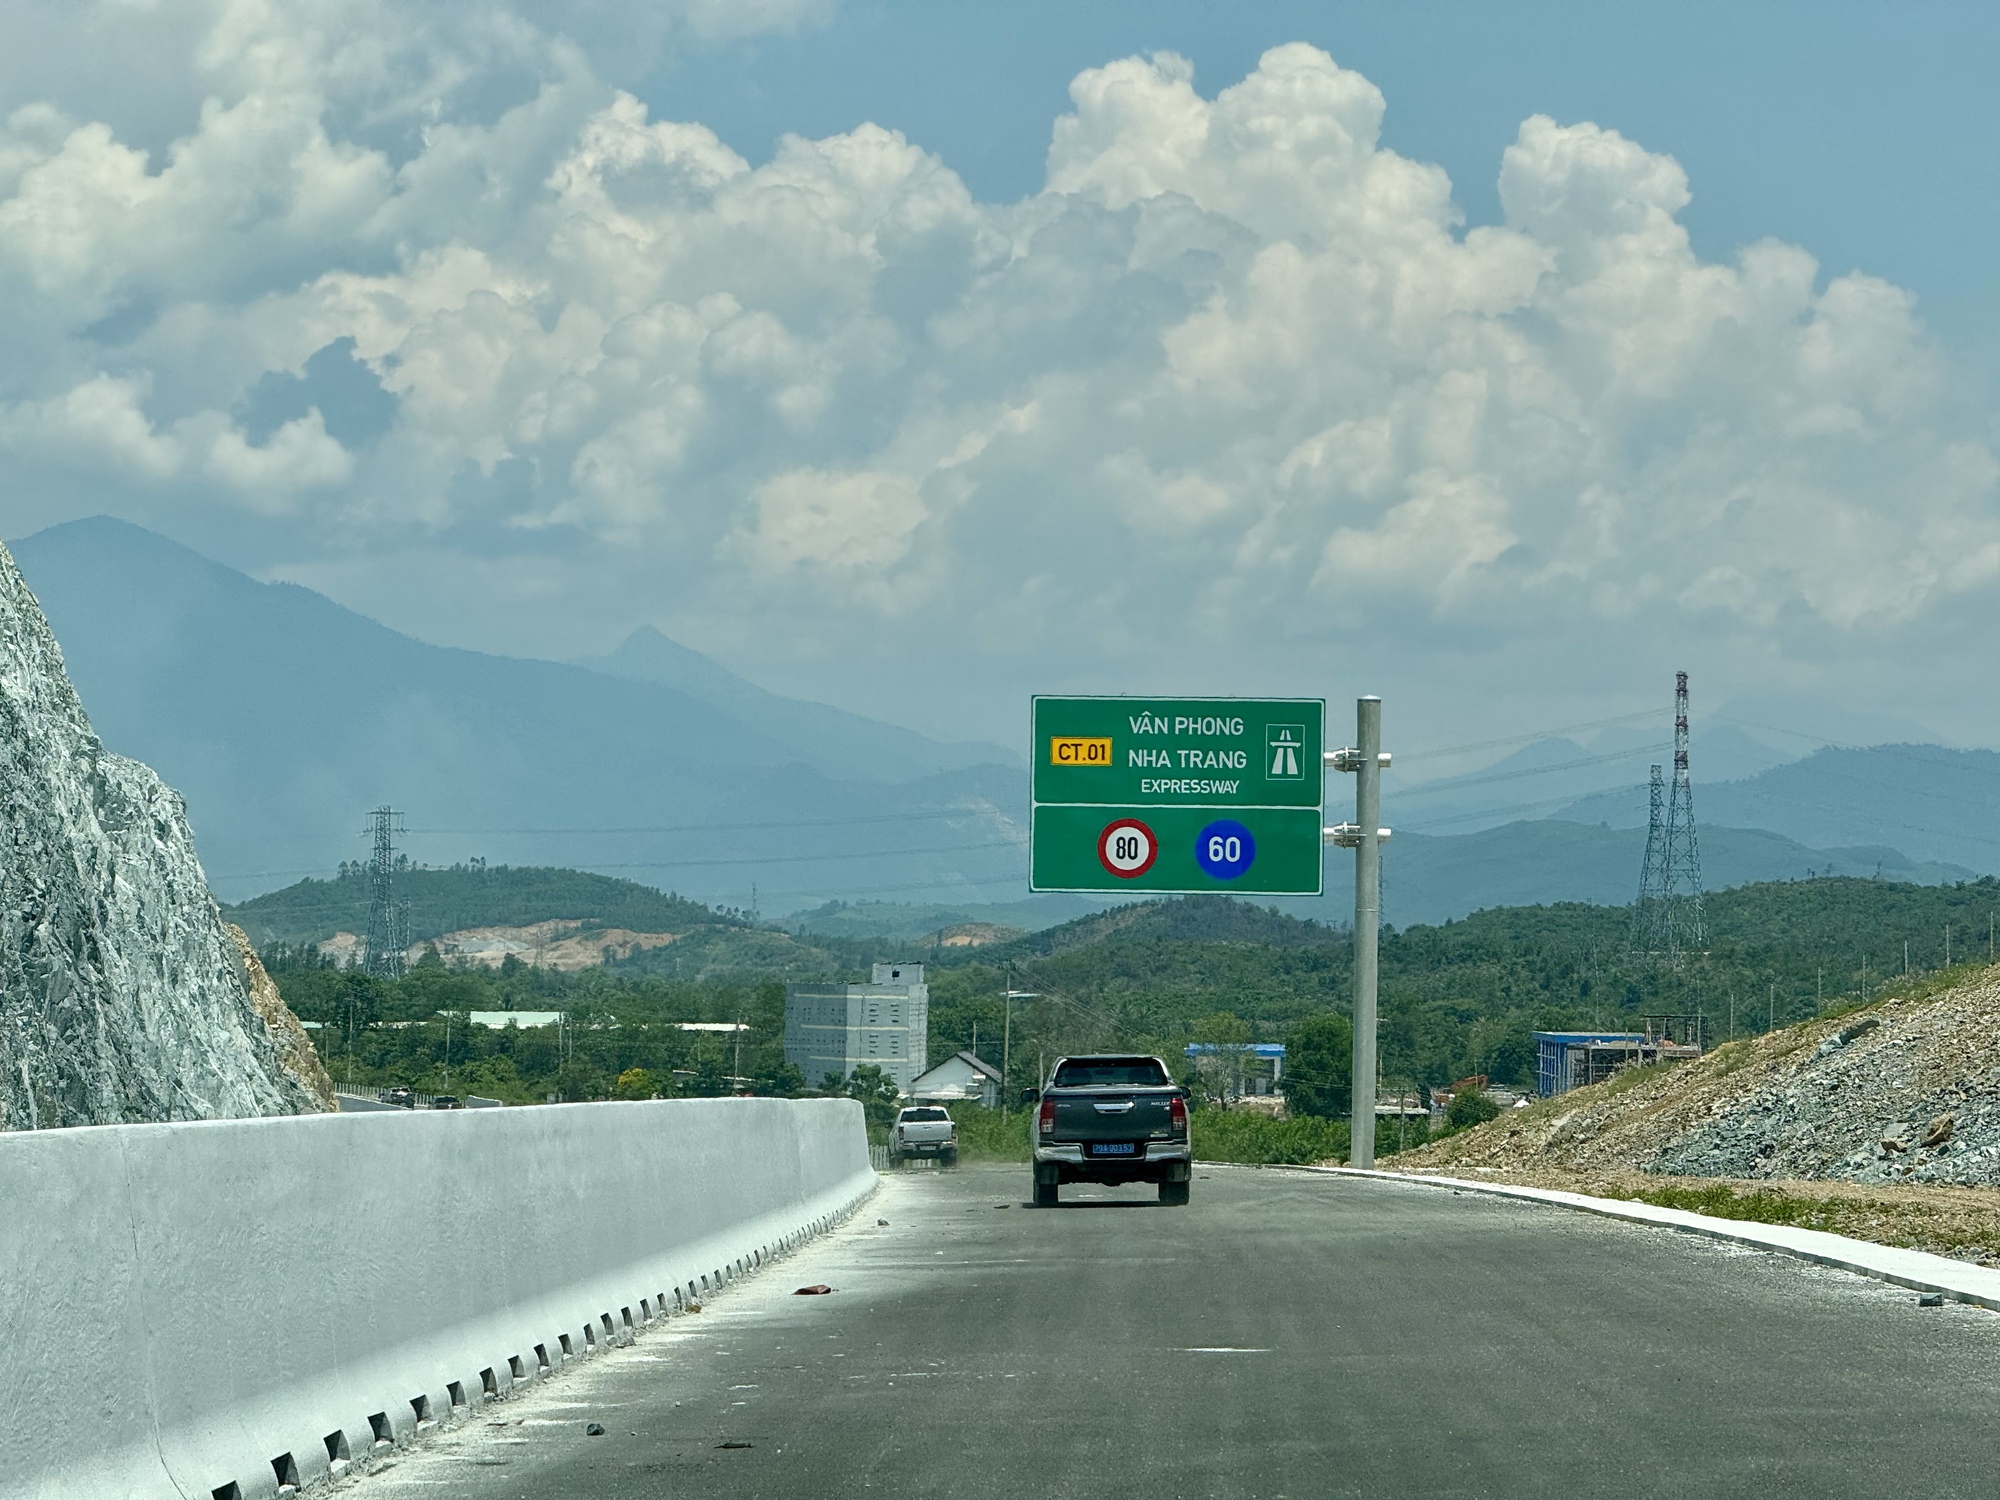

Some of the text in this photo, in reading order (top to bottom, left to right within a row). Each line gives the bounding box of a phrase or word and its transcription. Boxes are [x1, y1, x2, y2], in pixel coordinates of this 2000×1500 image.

[1129, 711, 1244, 735] VÂN PHONG
[1058, 743, 1107, 761] CT.01
[1128, 749, 1247, 769] NHA TRANG
[1141, 779, 1239, 794] EXPRESSWAY
[1115, 836, 1139, 861] 80
[1208, 836, 1241, 863] 60
